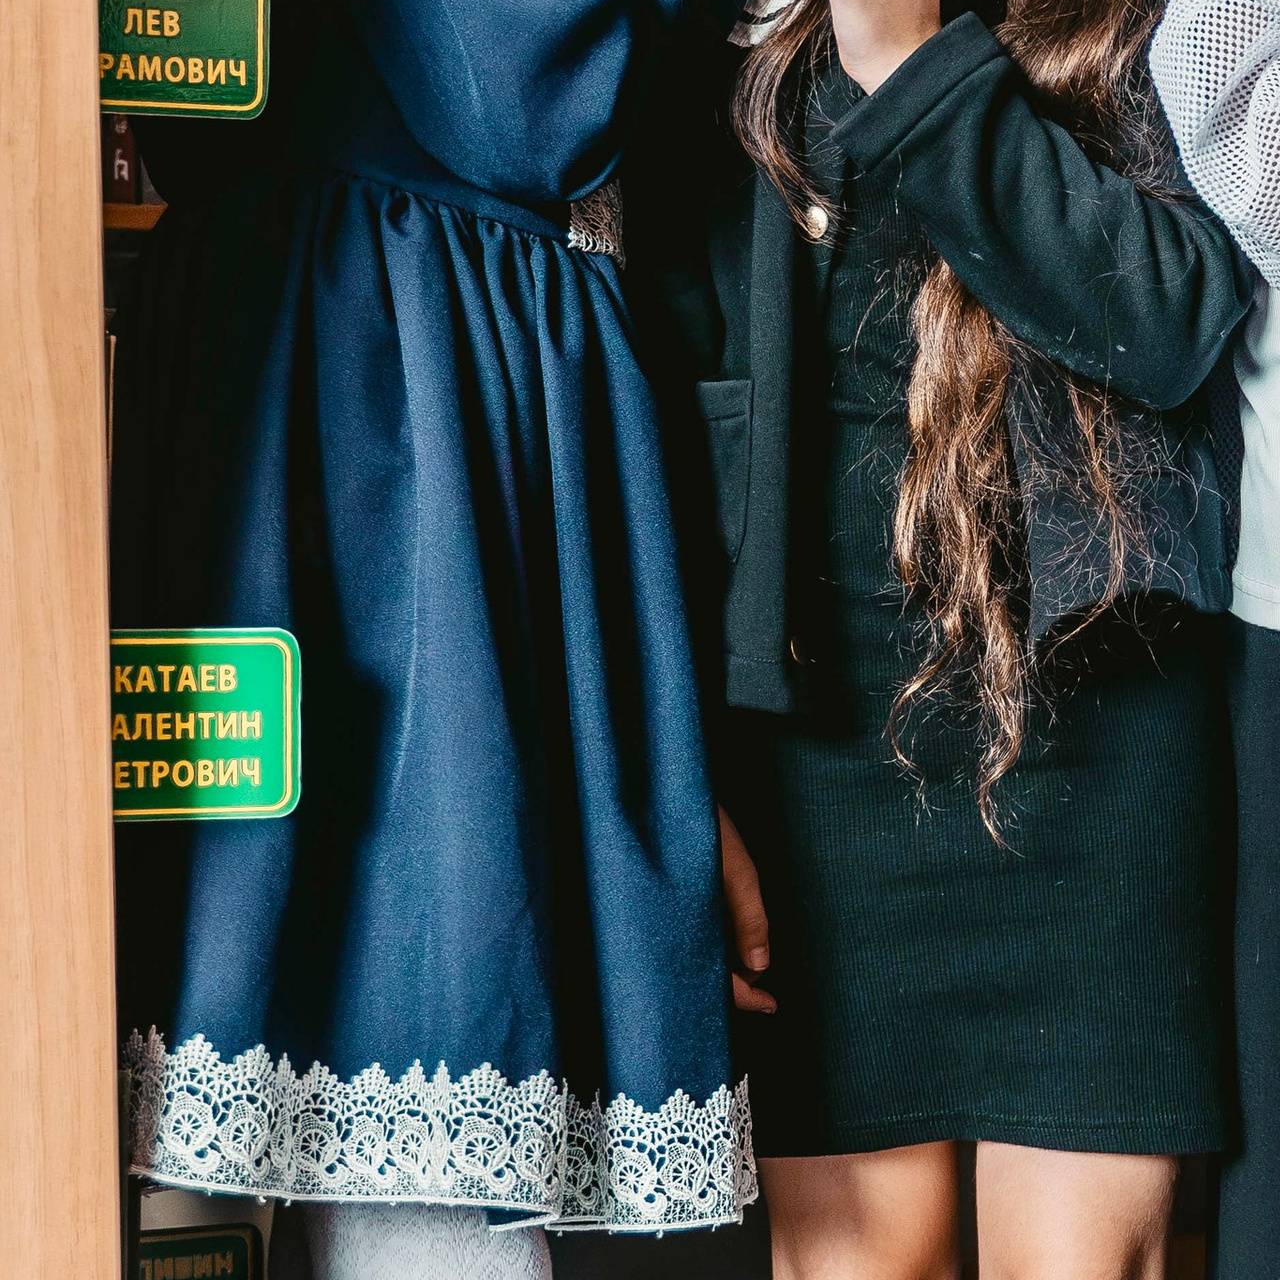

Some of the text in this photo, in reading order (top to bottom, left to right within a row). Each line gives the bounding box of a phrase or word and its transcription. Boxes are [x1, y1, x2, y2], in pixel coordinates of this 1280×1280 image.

[123, 7, 182, 39] ЛЕВ
[99, 52, 248, 88] РАМОВИЧ
[113, 664, 238, 694] КАТАЕВ
[111, 710, 263, 741] АЛЕНТИН
[113, 757, 262, 790] ЕТРОВИЧ
